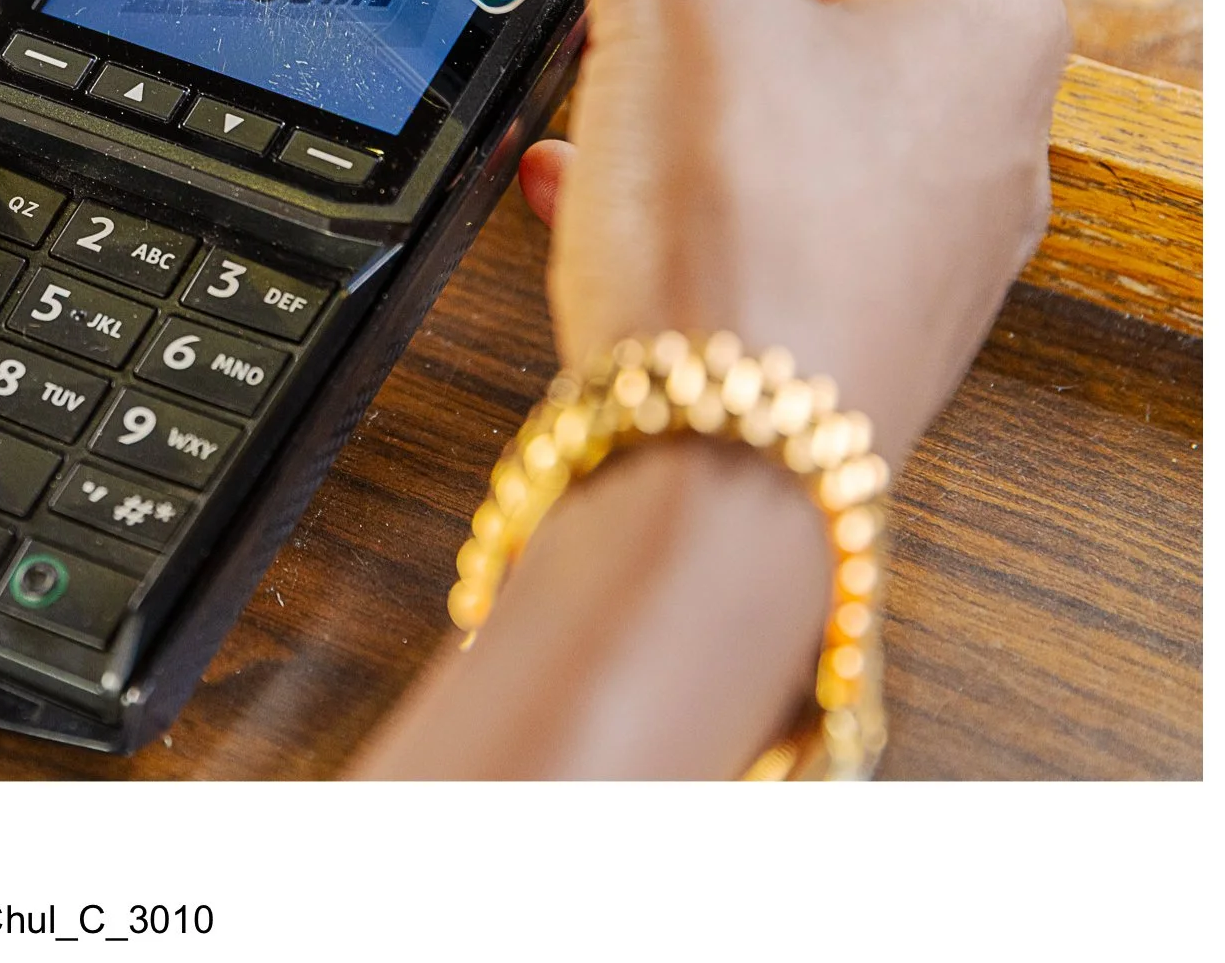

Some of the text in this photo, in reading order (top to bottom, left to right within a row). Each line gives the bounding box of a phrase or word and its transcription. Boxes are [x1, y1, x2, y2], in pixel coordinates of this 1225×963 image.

[8, 196, 40, 218] QZ
[76, 216, 176, 270] 2 ABC
[30, 286, 123, 339] 5 JKL
[206, 260, 308, 313] 3 DEF
[162, 335, 265, 386] 6 MNO
[41, 381, 86, 412] TUV
[121, 406, 218, 460] 9 WXY
